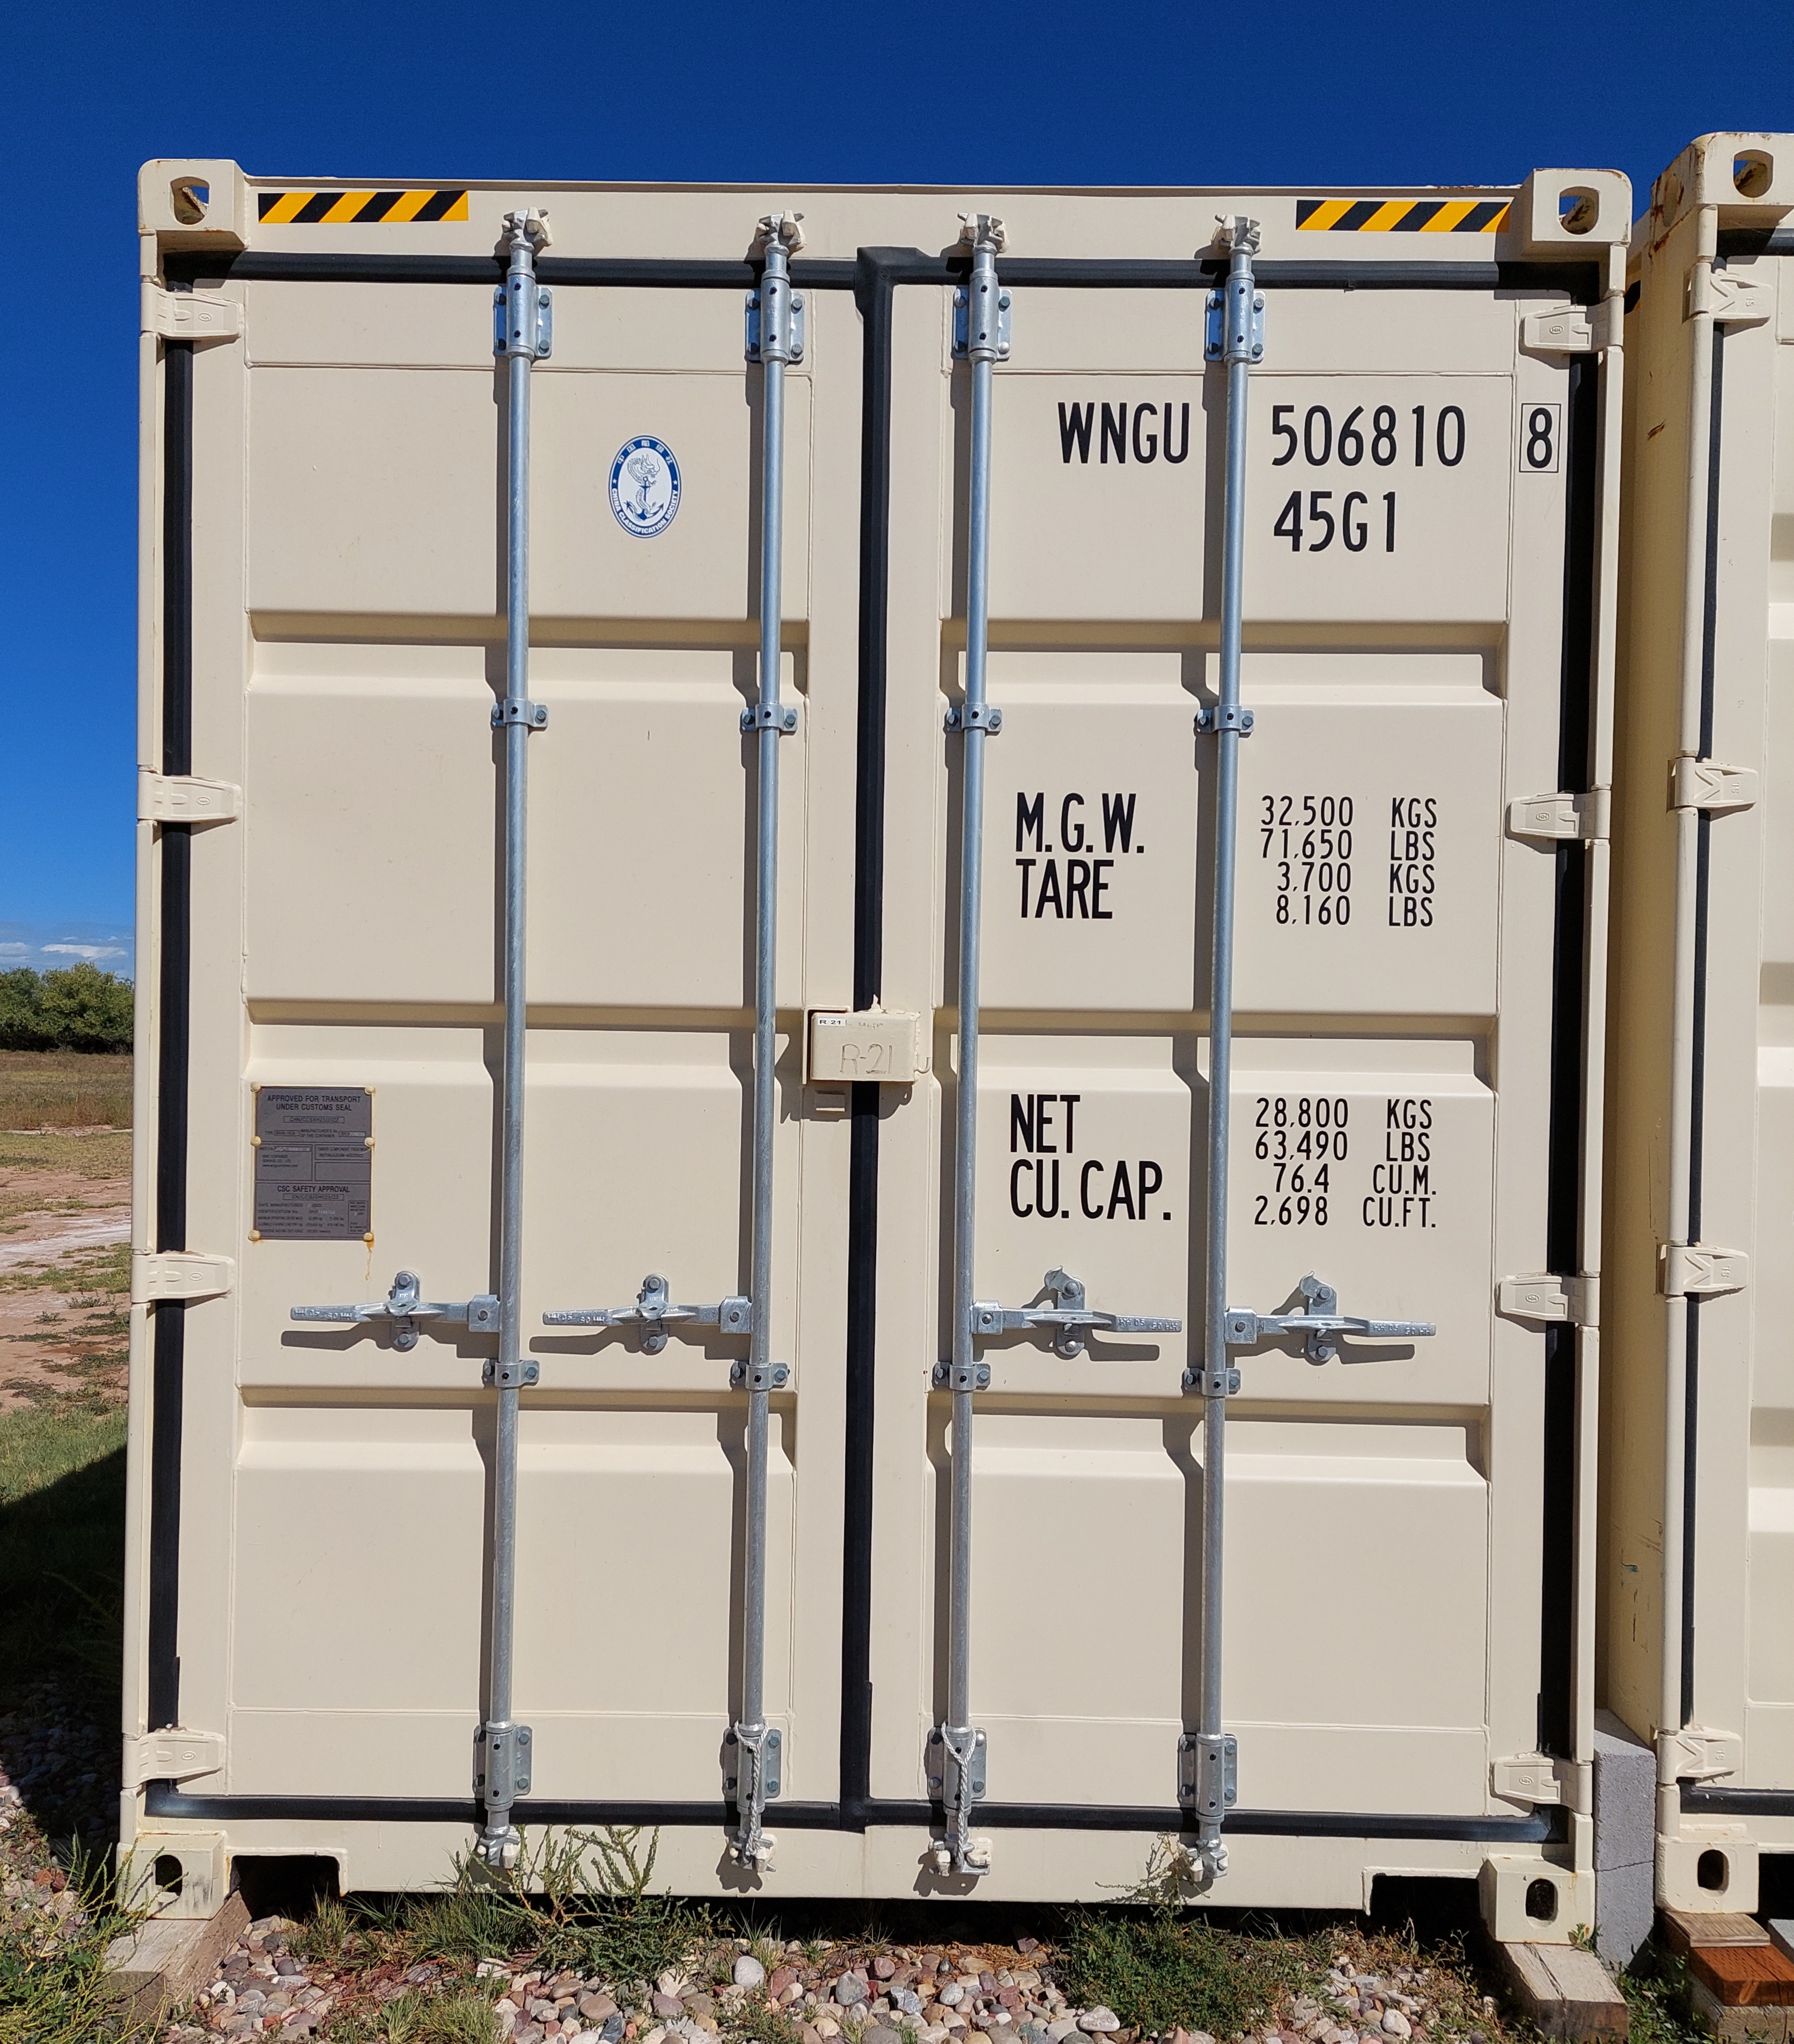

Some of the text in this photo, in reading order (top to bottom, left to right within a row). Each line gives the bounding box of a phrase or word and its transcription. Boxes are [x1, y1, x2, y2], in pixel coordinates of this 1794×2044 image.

[1057, 402, 1553, 469] WNGU 506810 8
[612, 488, 678, 534] CHINA CLASSIFICATION SOCIETY
[1274, 490, 1395, 553] 45G1
[1016, 792, 1145, 854] M.G.W.
[1261, 795, 1437, 829] 32,500 KGS
[1260, 828, 1435, 861] 71,650 LBS
[1015, 858, 1114, 919] TARE
[1277, 861, 1435, 894] 3,700 KGS
[1276, 894, 1433, 927] 8,160 LBS
[840, 1044, 892, 1074] R-21
[1010, 1094, 1080, 1154] NET
[1255, 1097, 1432, 1130] 28,800 KGS
[1255, 1130, 1430, 1162] 63,490 LBS
[1273, 1162, 1437, 1196] 76.4 CU.M.
[1254, 1195, 1436, 1228] 2,698 CU.FT.
